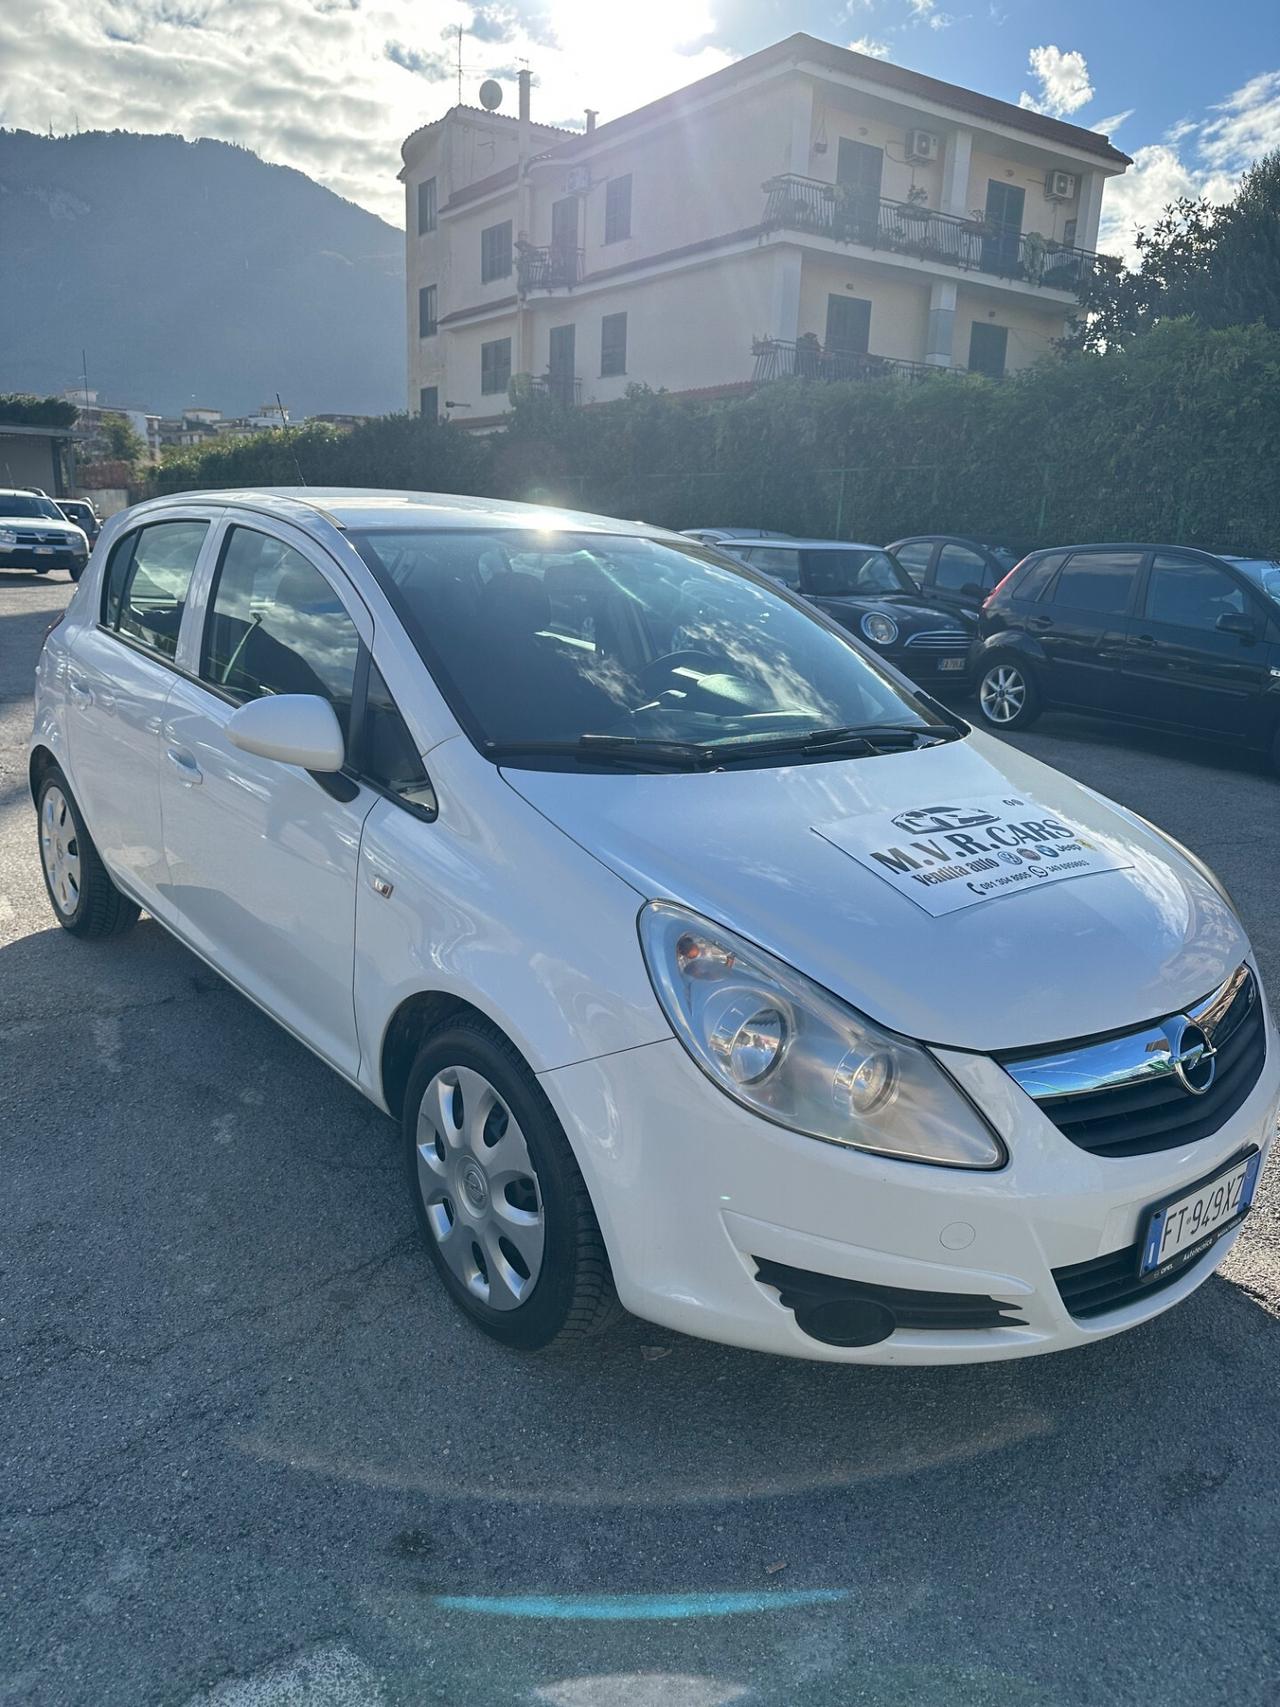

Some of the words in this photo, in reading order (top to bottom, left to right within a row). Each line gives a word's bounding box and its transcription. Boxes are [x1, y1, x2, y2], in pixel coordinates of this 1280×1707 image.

[912, 864, 971, 887] Vendita
[965, 858, 1000, 872] auto
[980, 881, 998, 890] 081
[995, 877, 1014, 885] 304
